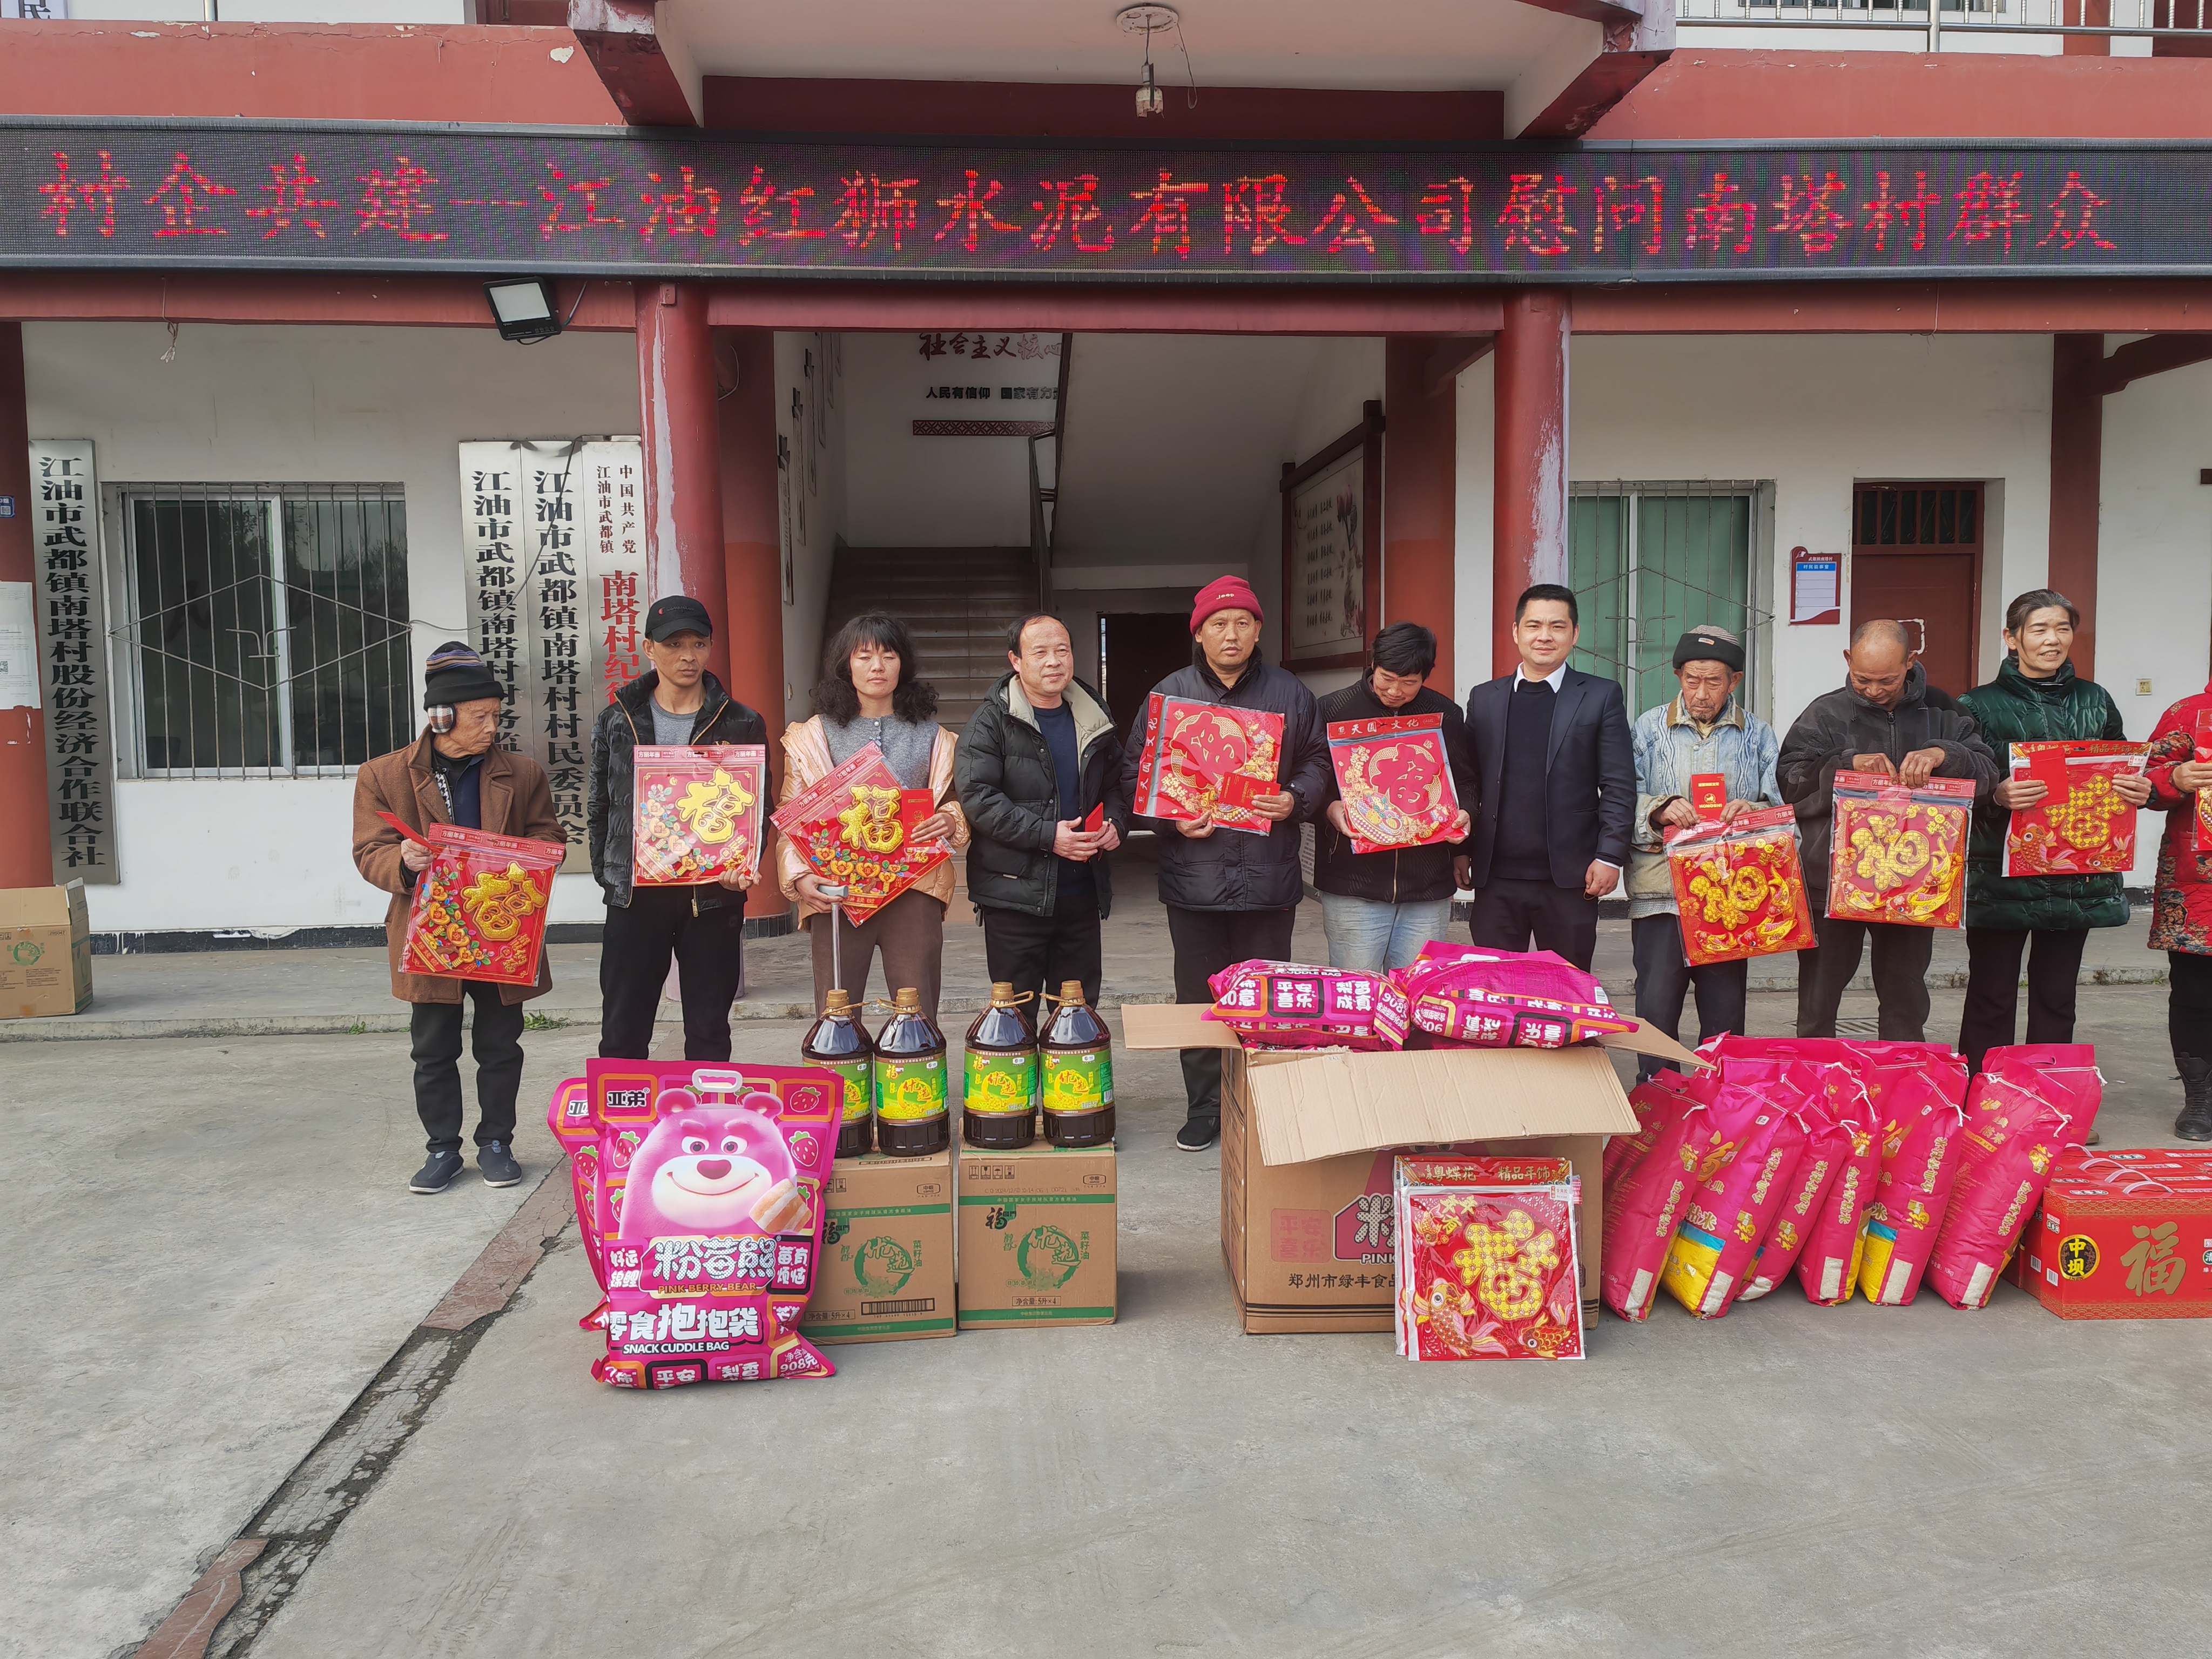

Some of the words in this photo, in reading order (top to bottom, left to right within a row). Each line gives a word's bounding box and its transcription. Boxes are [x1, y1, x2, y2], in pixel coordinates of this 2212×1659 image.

[926, 386, 991, 400] 人民有信仰
[596, 465, 615, 554] 江油市武都镇
[619, 464, 637, 554] 中国共产党
[38, 456, 106, 868] 江油市武都镇南塔村股份经济合作联合社
[532, 470, 588, 845] 江油市武都镇南塔村村民委员会
[676, 767, 756, 844] 福
[838, 784, 906, 854] 福
[2044, 773, 2128, 851] 福
[1850, 814, 1930, 890] 福
[461, 860, 548, 941] 福
[1689, 857, 1769, 930] 福
[1277, 981, 1312, 993] 平安
[1277, 993, 1313, 1009] 喜乐
[607, 1090, 647, 1108] 亚弟
[1498, 1165, 1551, 1182] 精品年饰
[1280, 1216, 1322, 1236] 平安
[610, 1249, 639, 1267] 好运
[652, 1237, 777, 1282] 粉莓熊
[913, 1240, 922, 1268] 菜籽油
[1080, 1231, 1090, 1260] 菜籽油
[1279, 1238, 1321, 1259] 喜乐
[2067, 1238, 2086, 1277] 中坝
[2120, 1221, 2187, 1297] 福
[609, 1269, 638, 1290] 锦鲤
[777, 1267, 806, 1286] 烦恼
[1453, 1209, 1560, 1321] 福
[658, 1284, 686, 1294] PINK
[689, 1283, 725, 1293] BERRY
[727, 1282, 757, 1291] BEAR
[610, 1303, 759, 1341] 零食抱抱袋
[623, 1343, 659, 1354] SNACK
[660, 1343, 704, 1353] CUDDLE
[706, 1341, 729, 1351] BAG
[656, 1369, 696, 1382] 平安
[780, 1353, 818, 1373] 908克
